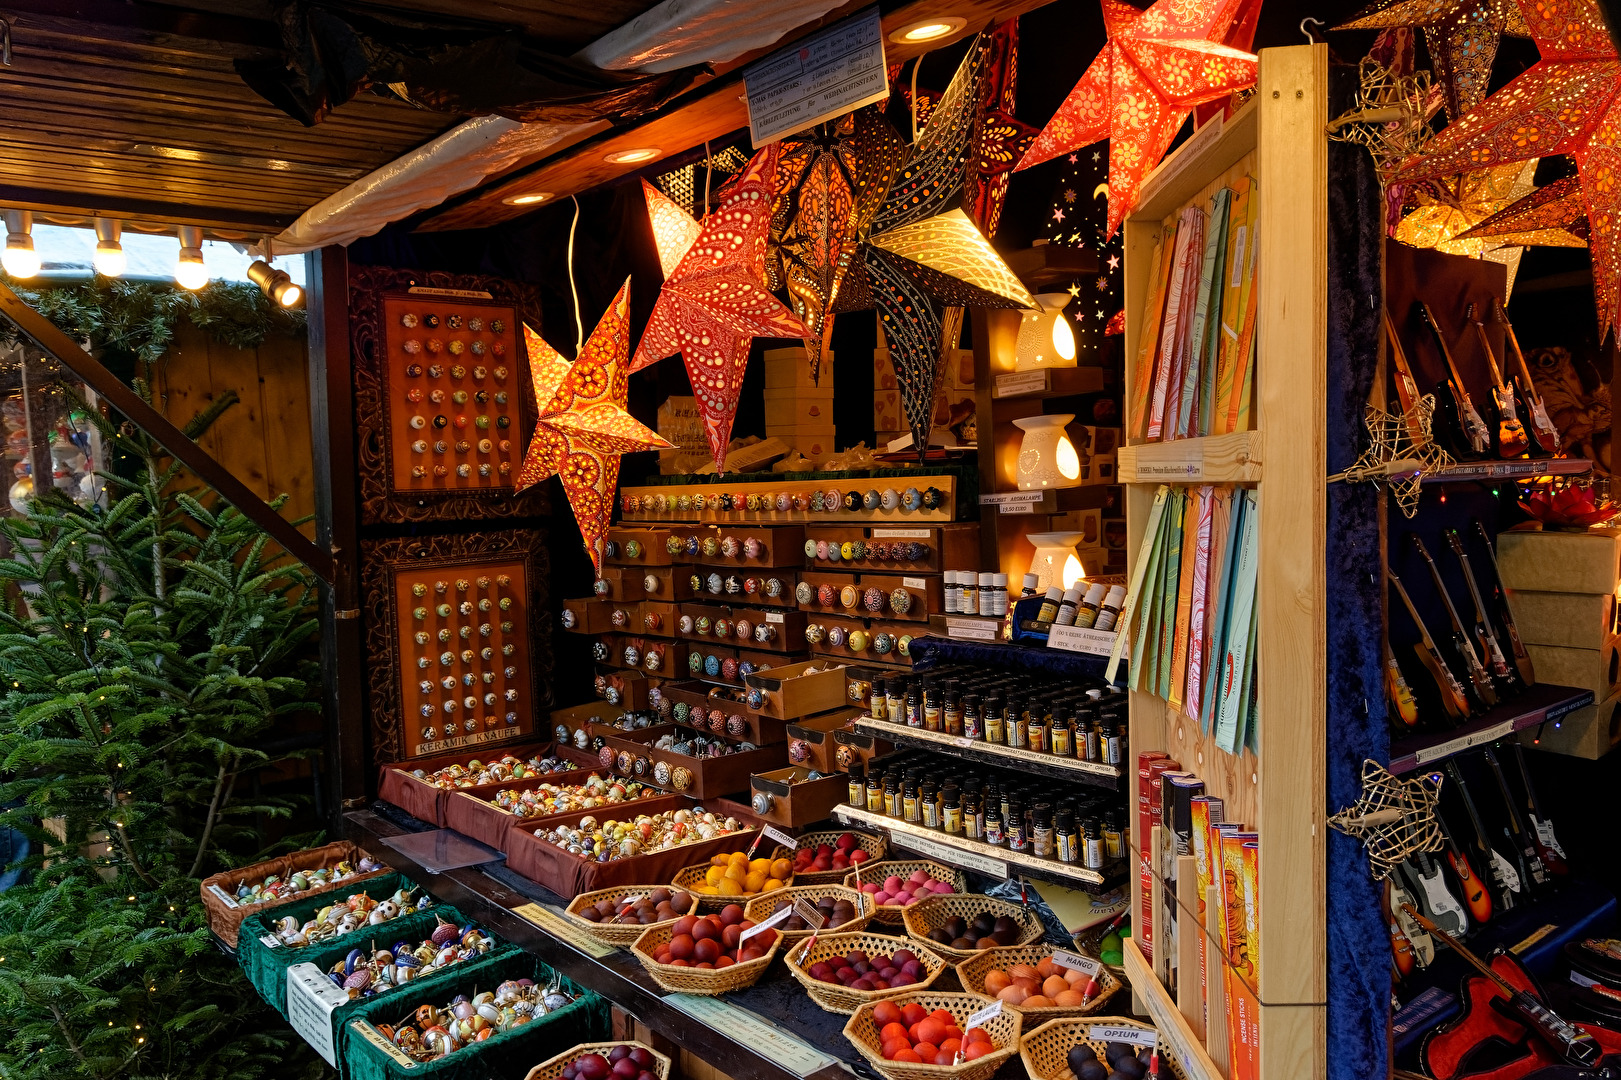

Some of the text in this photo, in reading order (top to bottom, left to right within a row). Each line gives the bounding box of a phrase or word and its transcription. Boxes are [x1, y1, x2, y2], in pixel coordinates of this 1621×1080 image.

[1010, 494, 1042, 502] AROMALAMPE
[419, 736, 468, 754] KERAMIK
[770, 829, 795, 845] CITRONE
[1065, 956, 1093, 969] MANGO
[1238, 997, 1248, 1044] INCENSE STICKS
[1104, 1030, 1139, 1039] OPIUM
